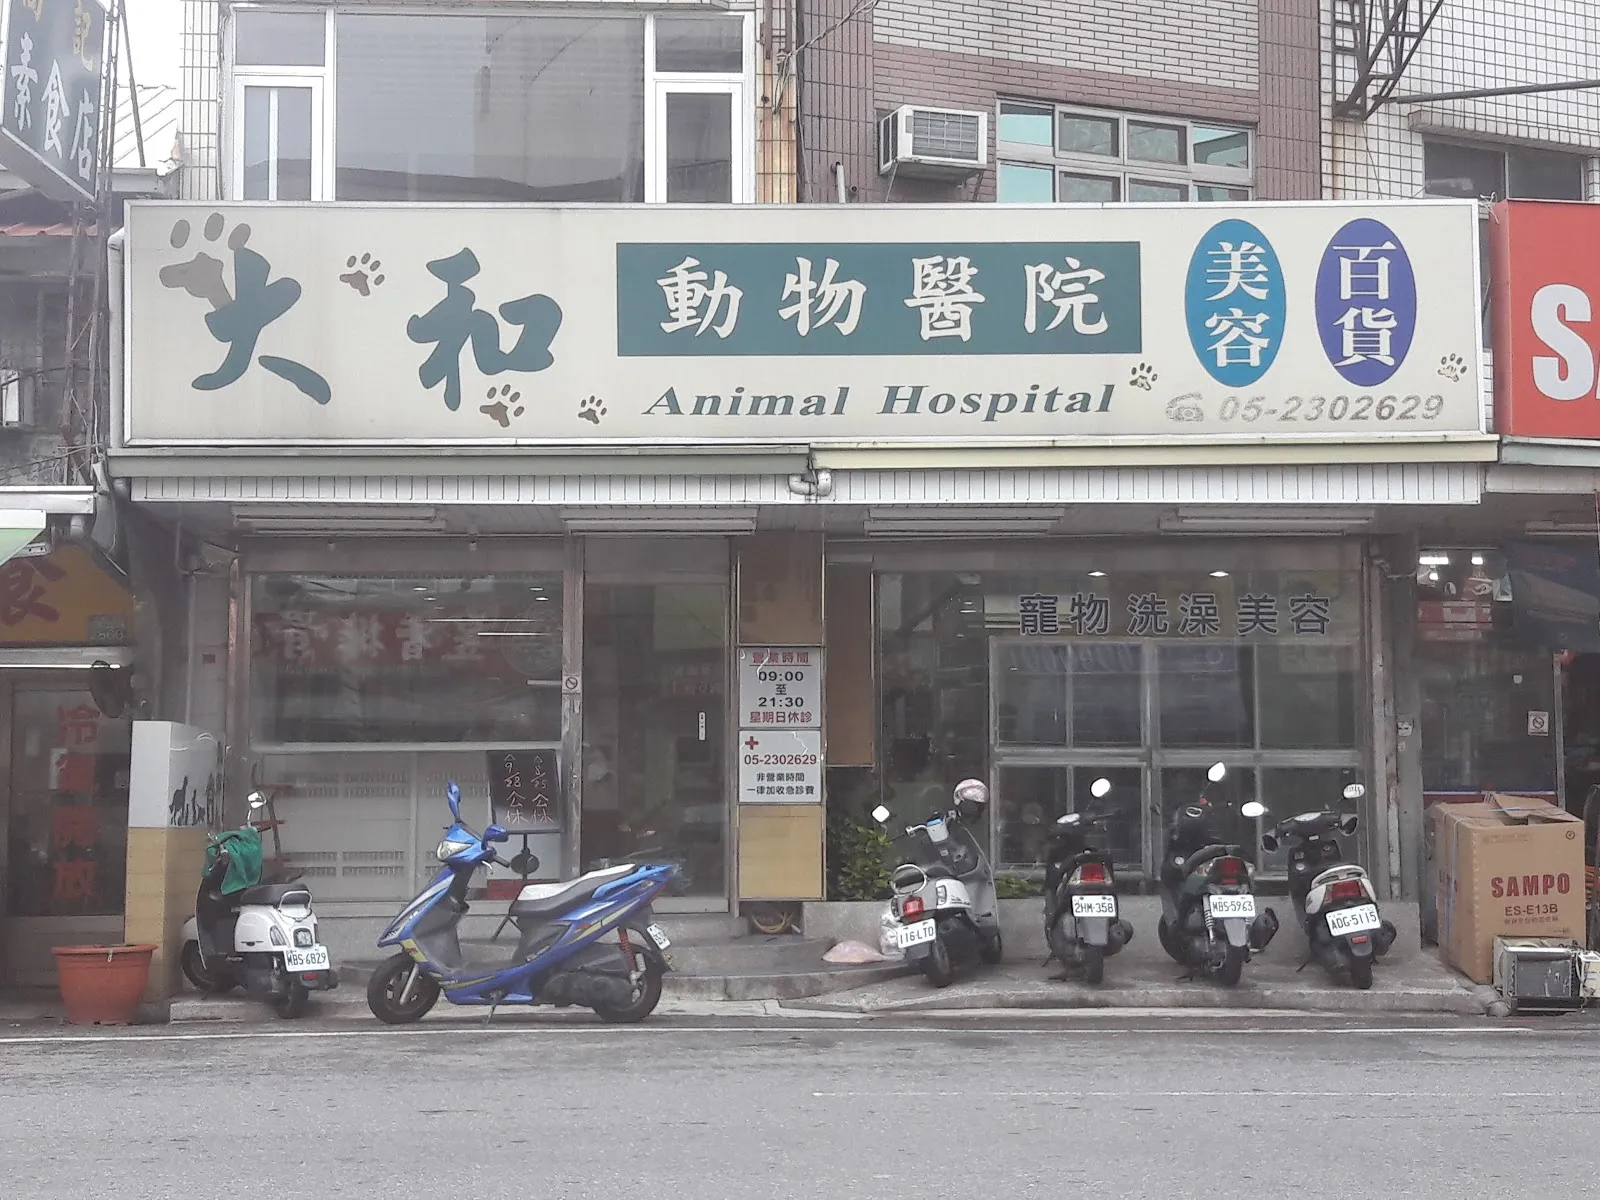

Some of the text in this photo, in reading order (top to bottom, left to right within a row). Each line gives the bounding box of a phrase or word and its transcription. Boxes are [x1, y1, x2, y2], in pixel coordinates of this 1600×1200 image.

[10, 31, 94, 181] 素食店
[656, 255, 1109, 342] 動物醫院
[1204, 240, 1271, 368] 美容
[1331, 240, 1398, 368] 百貨
[191, 247, 564, 412] 大和
[641, 383, 1116, 422] Animal Hospital
[1218, 394, 1444, 422] 05-2302629
[1018, 592, 1331, 636] 寵物洗澡美容
[758, 670, 804, 682] 09:00
[775, 683, 788, 696] 至
[758, 696, 804, 708] 21:30
[749, 710, 813, 724] 星期日休診
[744, 754, 817, 765] 05-2302629
[756, 772, 806, 782] 非營業時間
[1490, 872, 1571, 898] SAMPO
[1504, 903, 1559, 917] ES-E13B
